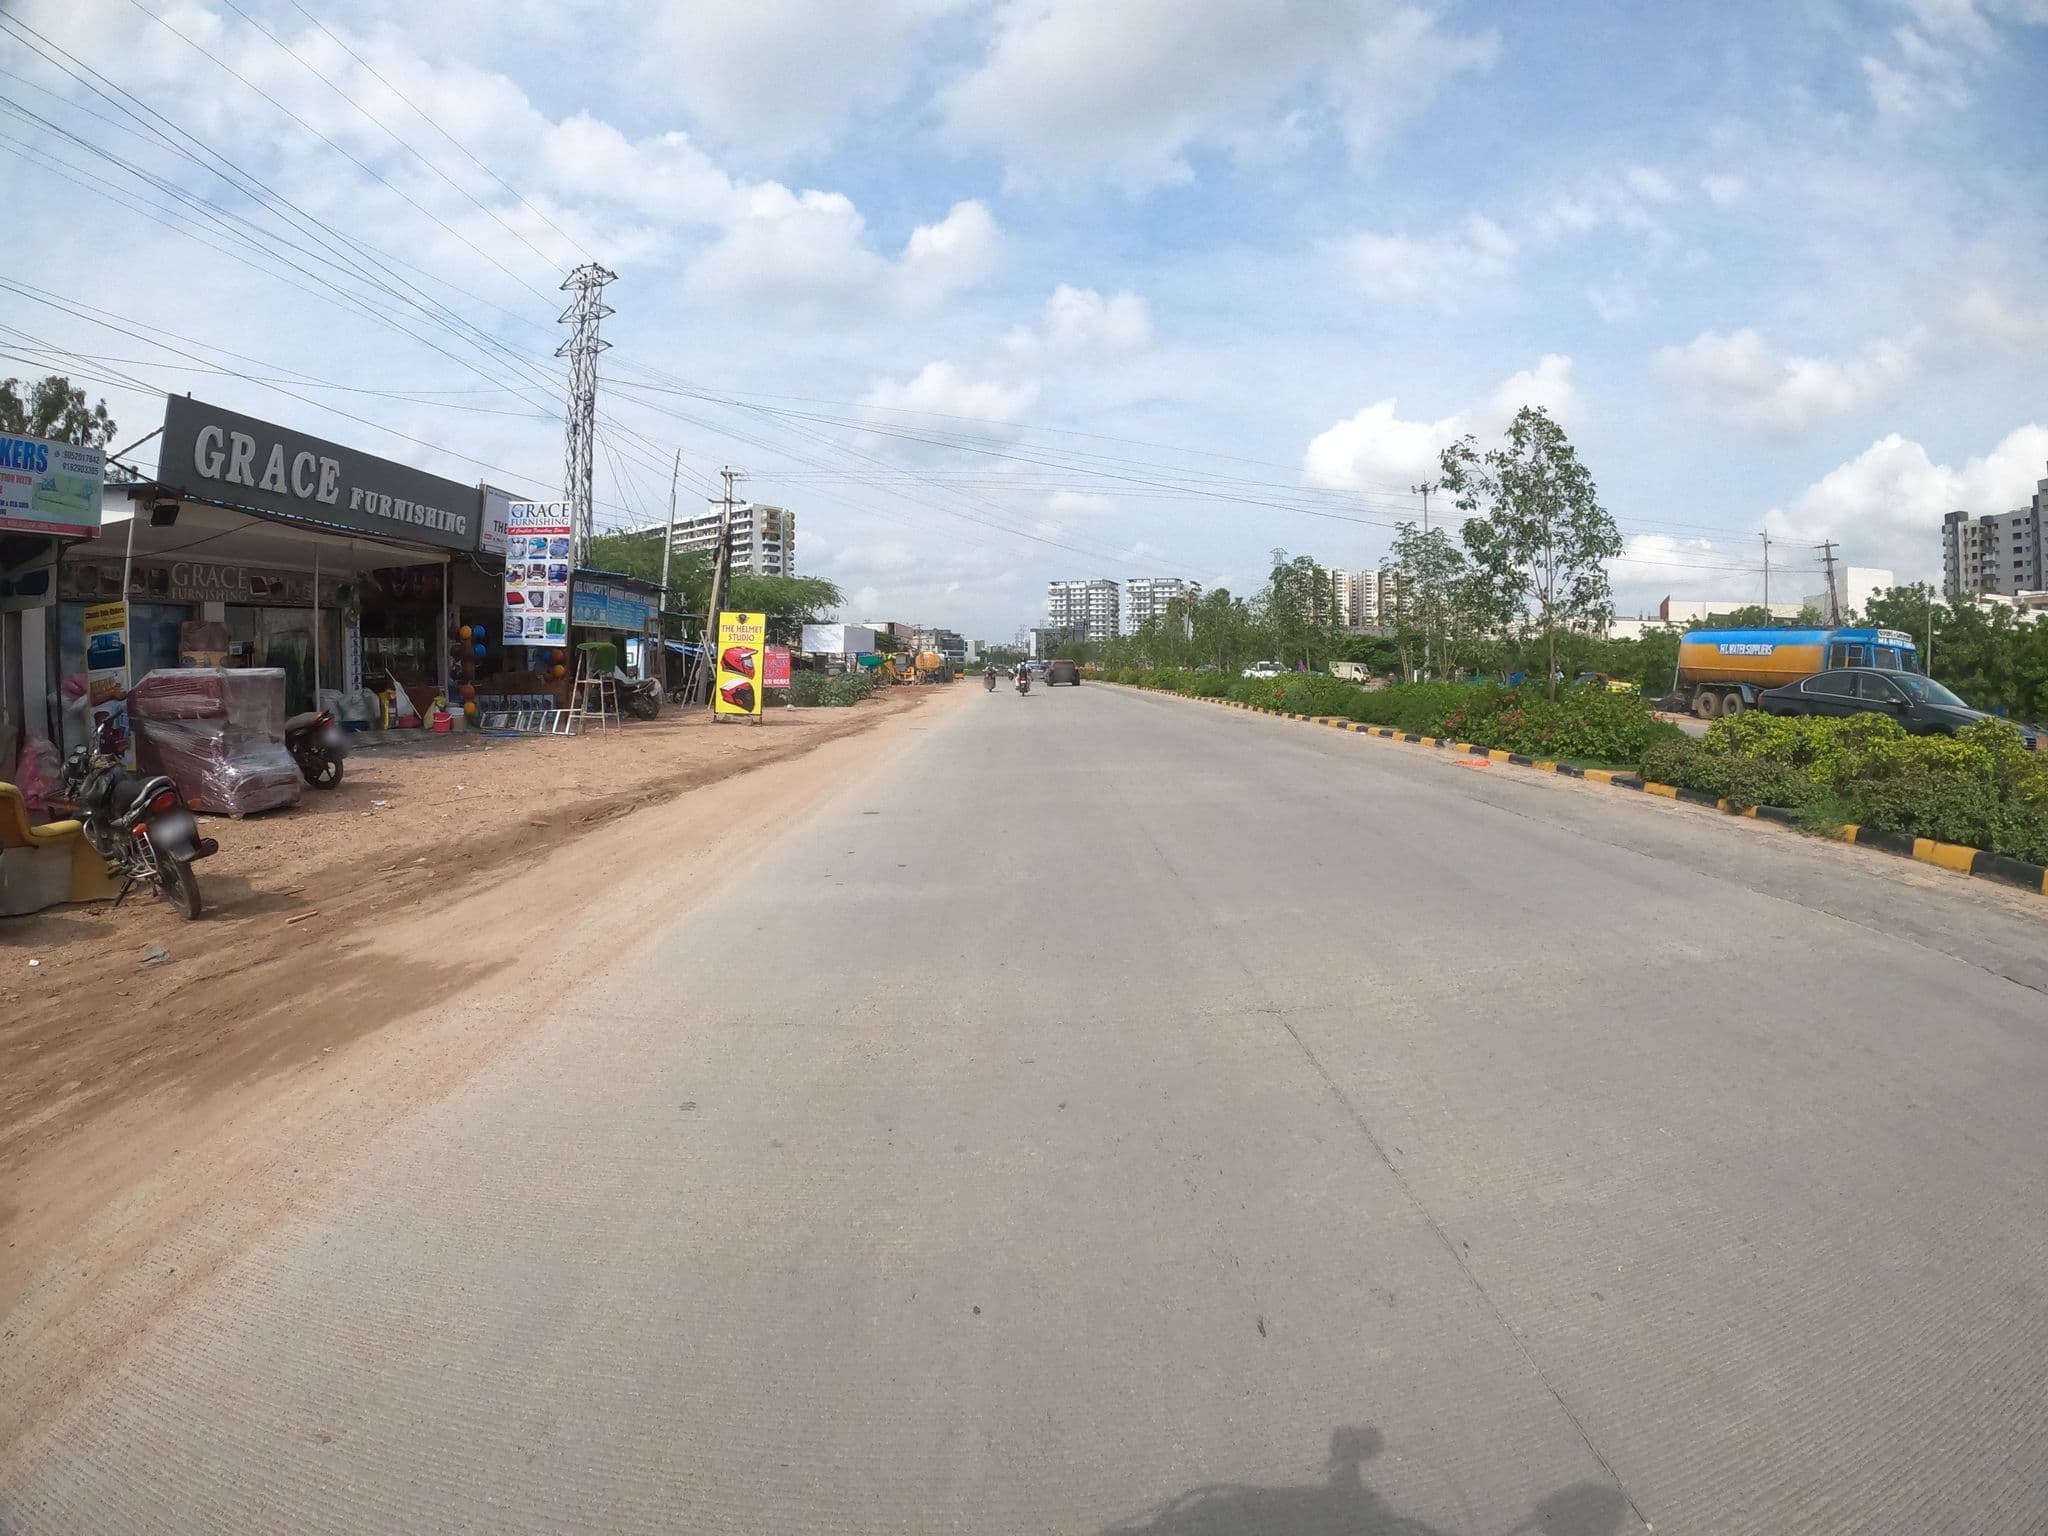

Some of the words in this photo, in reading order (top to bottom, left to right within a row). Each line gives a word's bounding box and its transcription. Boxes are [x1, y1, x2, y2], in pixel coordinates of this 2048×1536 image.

[193, 425, 341, 505] GRACE
[348, 487, 467, 536] FURNISHING
[511, 503, 570, 518] GRACE
[511, 517, 569, 527] FURNISHING
[171, 562, 248, 590] GRACE
[171, 586, 248, 602] FURNISHING
[722, 624, 735, 633] THE
[736, 625, 763, 634] HELMET
[728, 633, 755, 642] STUDIO
